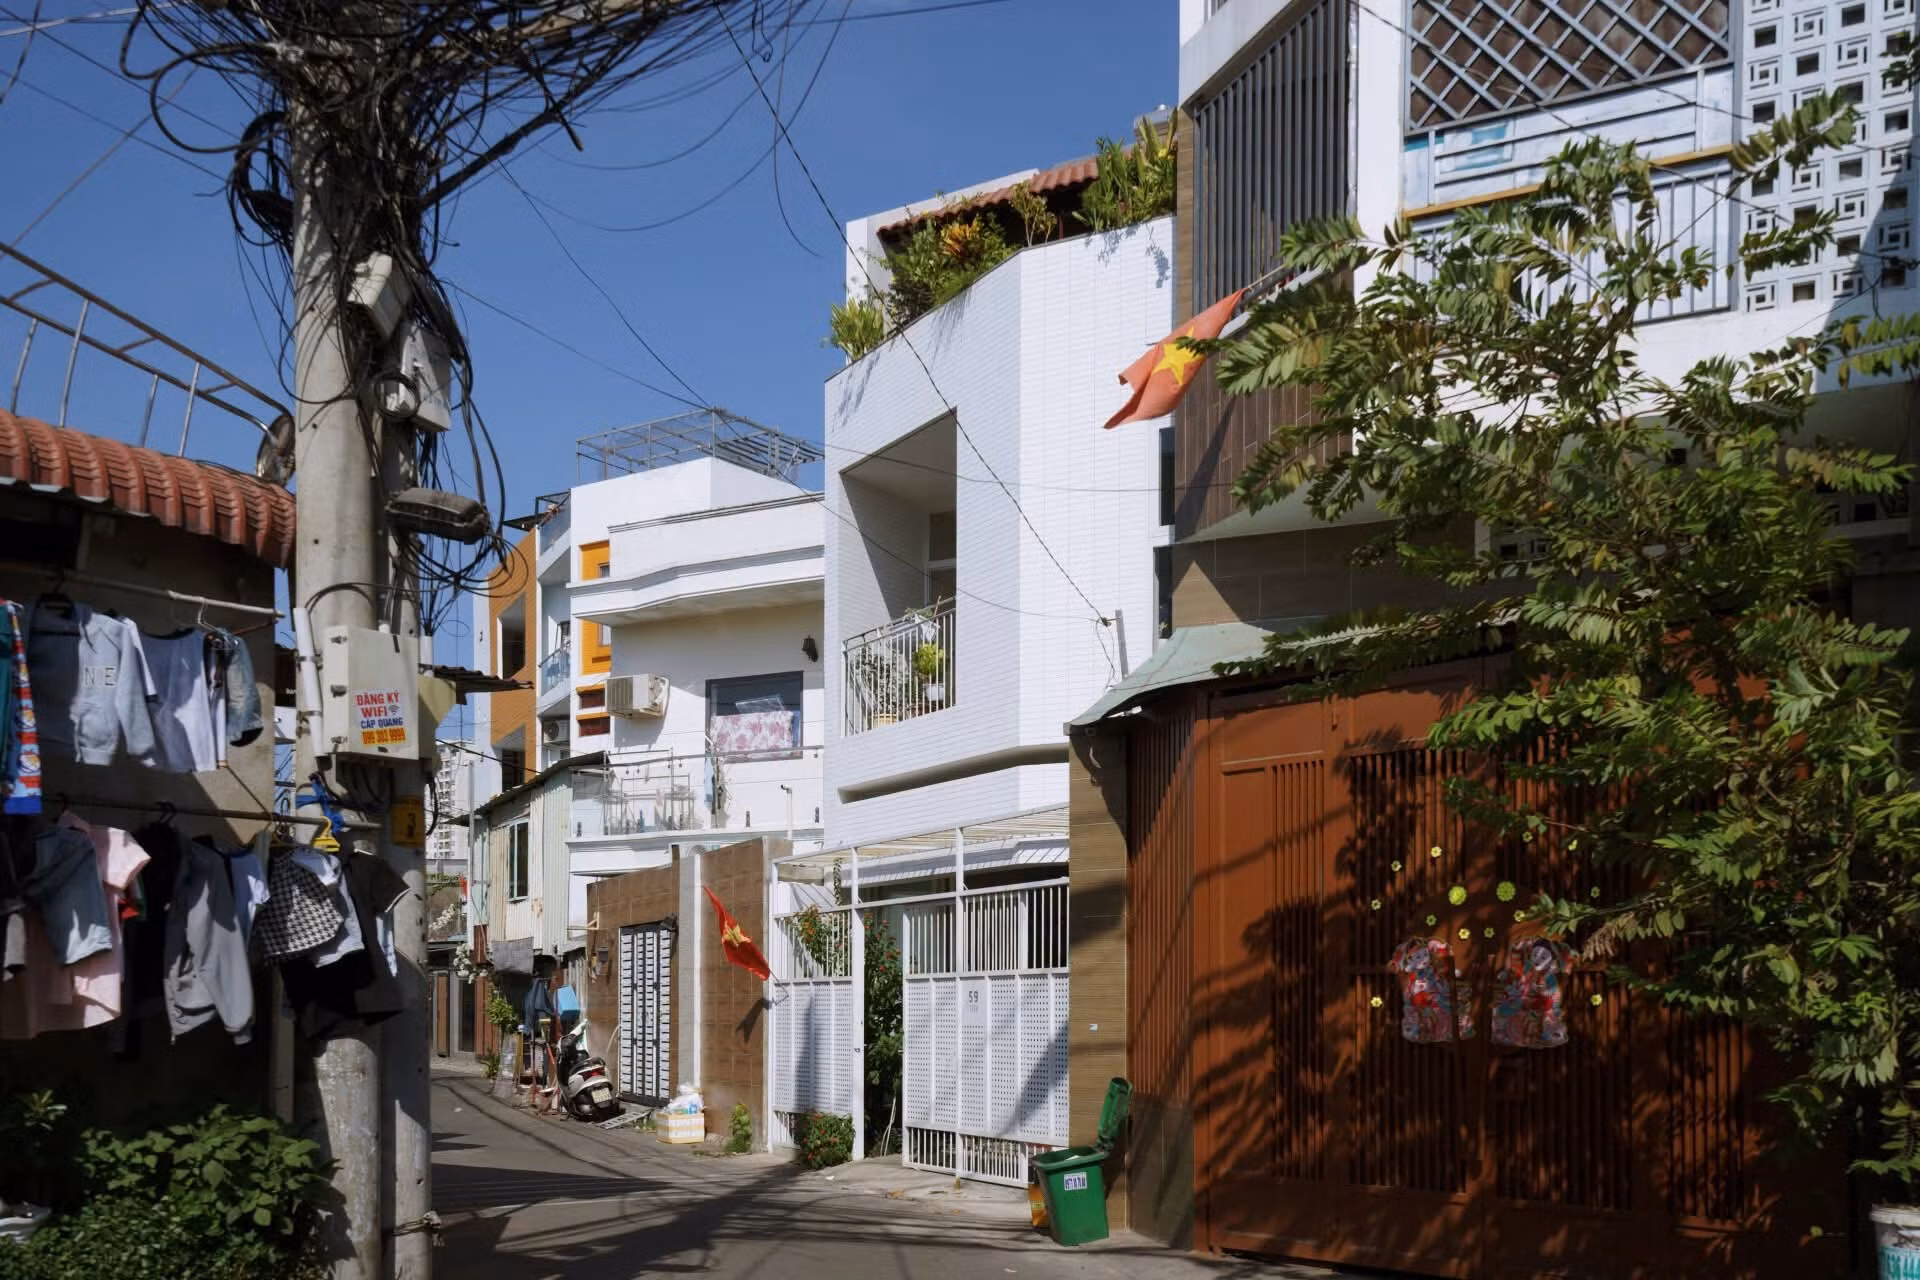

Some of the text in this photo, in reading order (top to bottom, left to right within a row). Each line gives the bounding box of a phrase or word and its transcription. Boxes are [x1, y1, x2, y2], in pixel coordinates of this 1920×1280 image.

[361, 706, 388, 718] WIFI
[377, 717, 404, 728] QUANG
[968, 990, 979, 1003] 59
